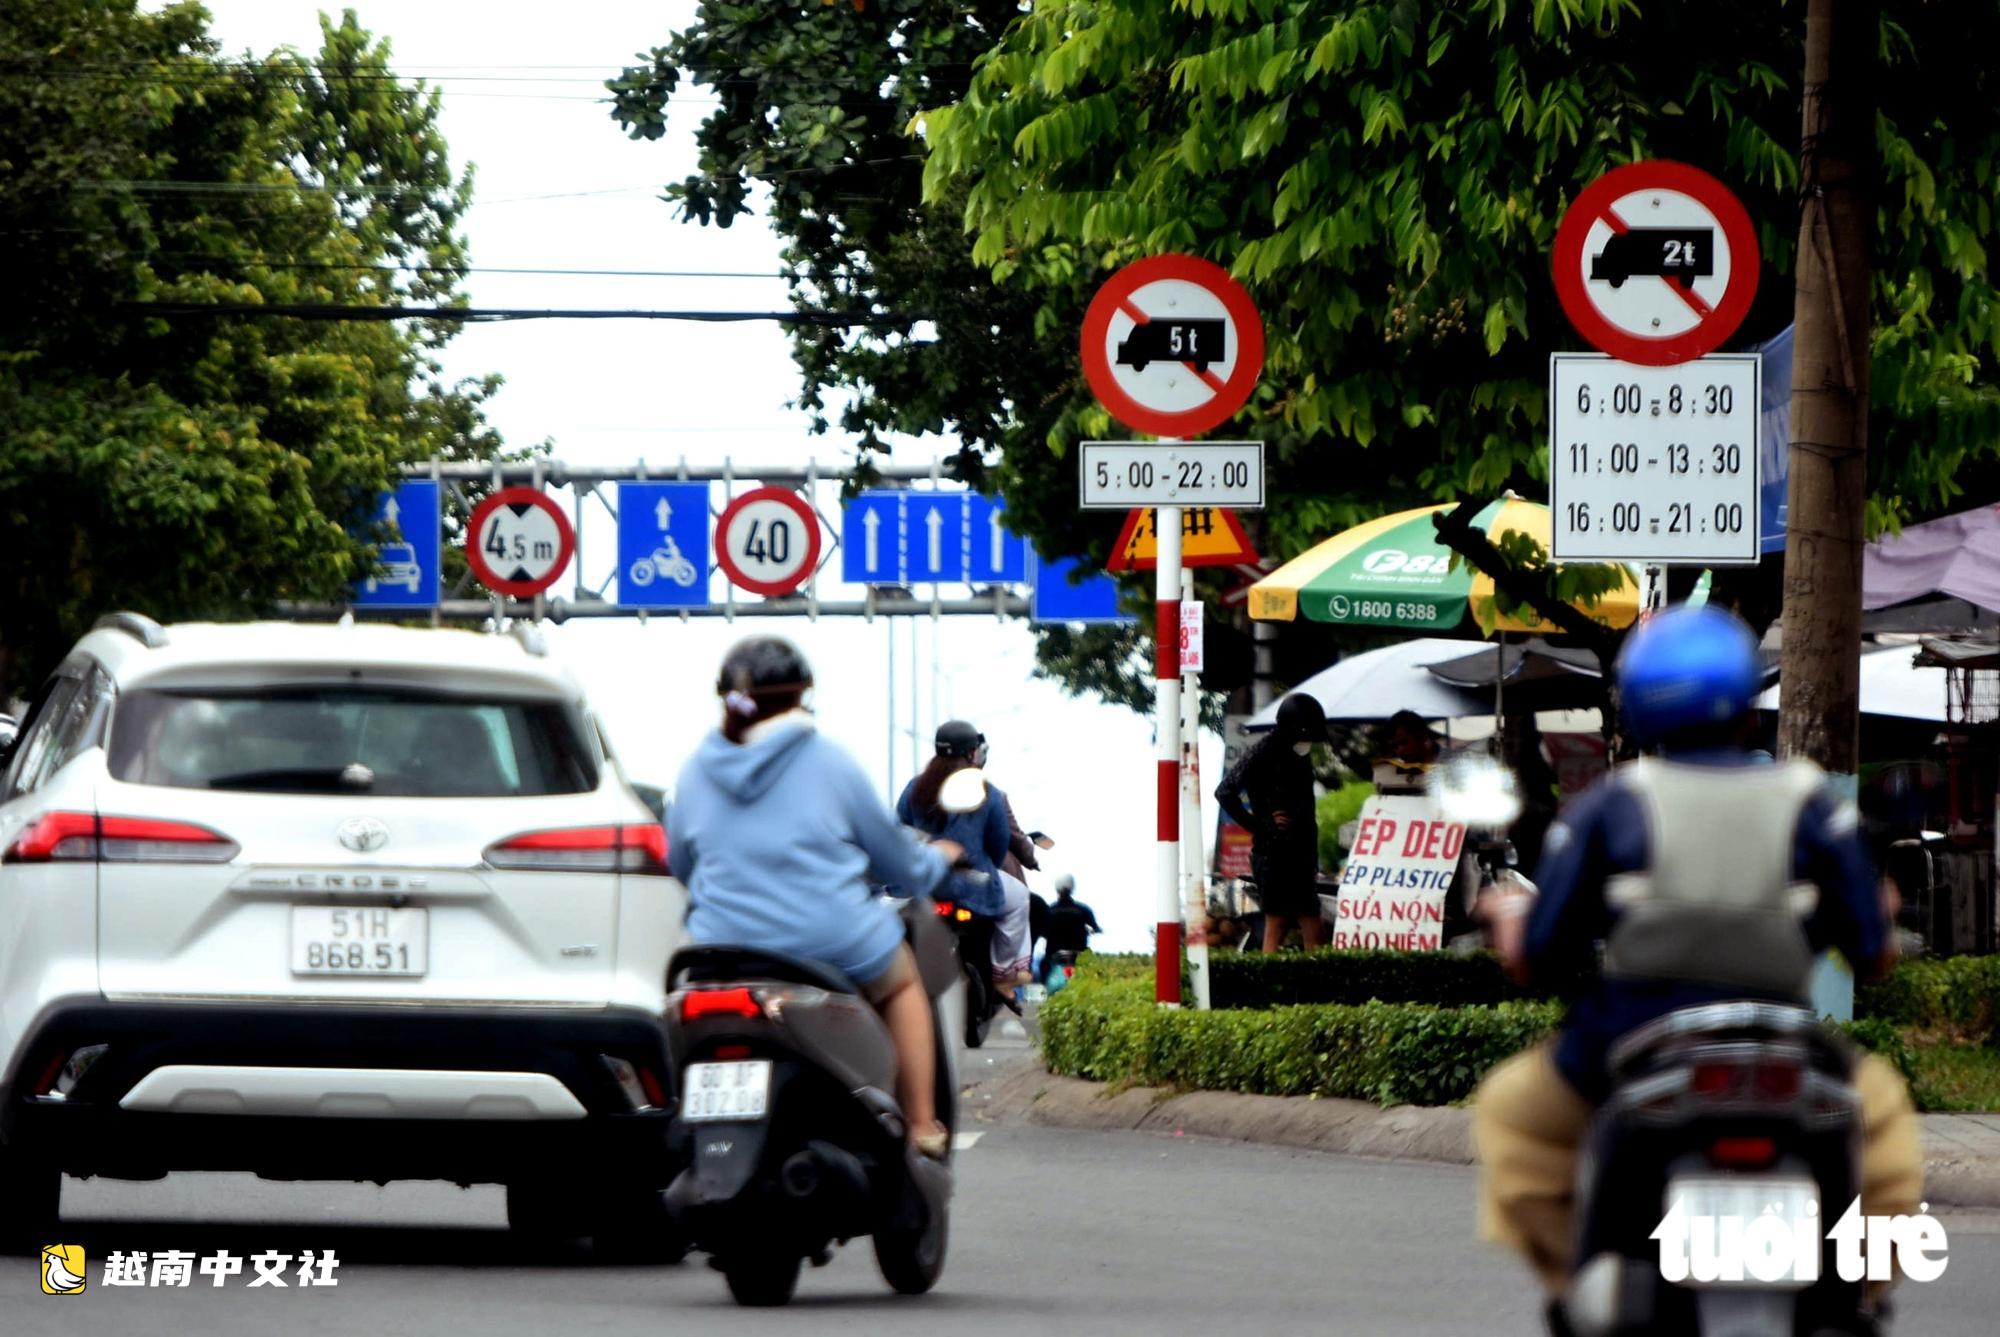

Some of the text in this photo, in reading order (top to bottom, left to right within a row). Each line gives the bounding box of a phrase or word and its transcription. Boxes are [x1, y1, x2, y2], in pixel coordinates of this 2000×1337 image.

[1662, 239, 1696, 266] 2t
[744, 519, 790, 564] 40
[1351, 600, 1437, 621] 1800 6388
[1369, 866, 1454, 891] PLASTIC
[331, 909, 389, 938] 51H
[307, 941, 410, 970] 868.51
